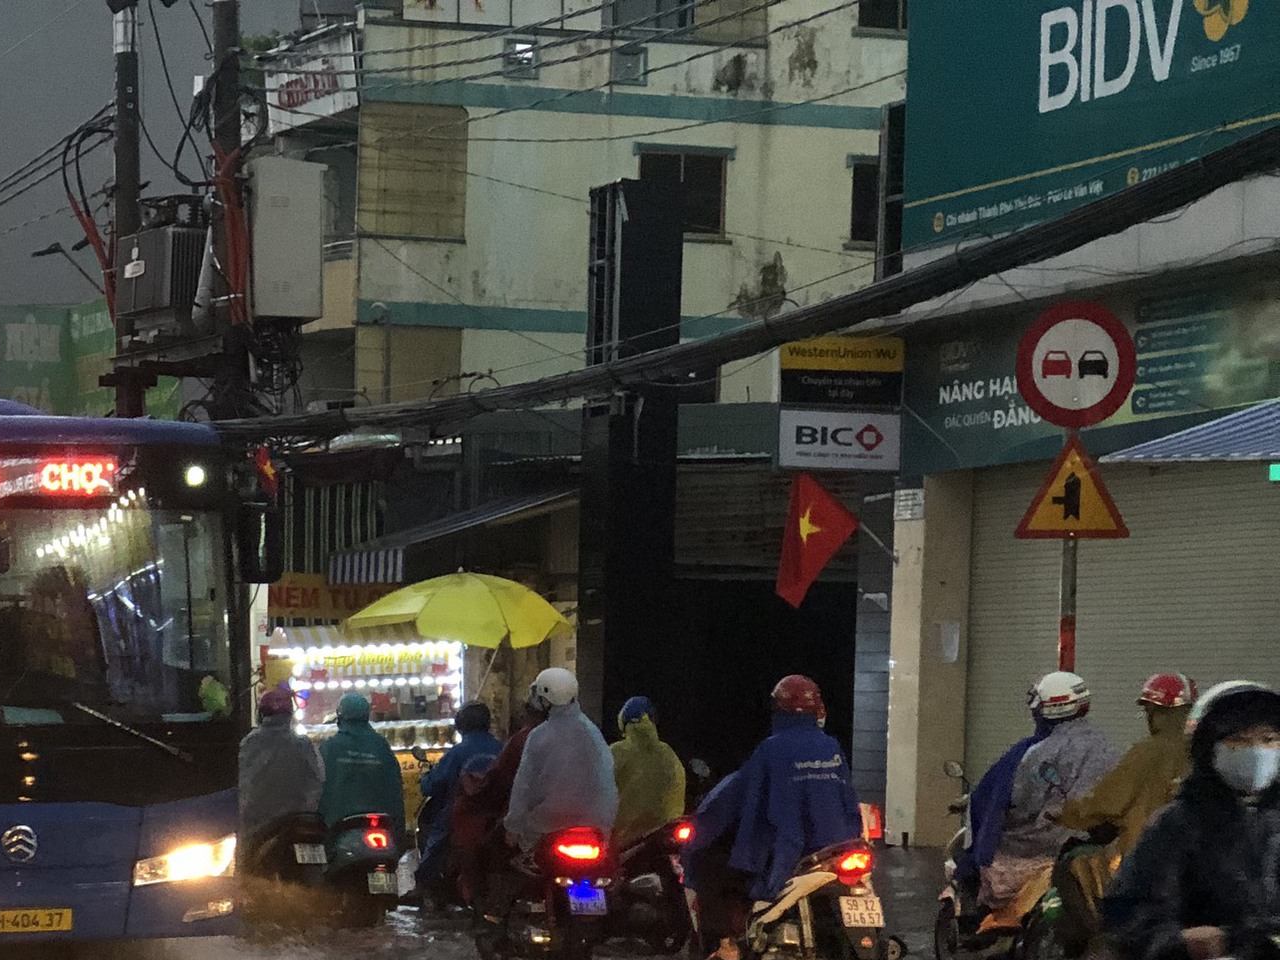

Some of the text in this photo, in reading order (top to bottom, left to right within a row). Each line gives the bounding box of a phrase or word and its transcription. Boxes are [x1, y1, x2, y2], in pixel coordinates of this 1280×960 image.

[1038, 0, 1184, 114] BIDV
[1190, 55, 1219, 73] Since
[939, 379, 985, 405] NÂNG
